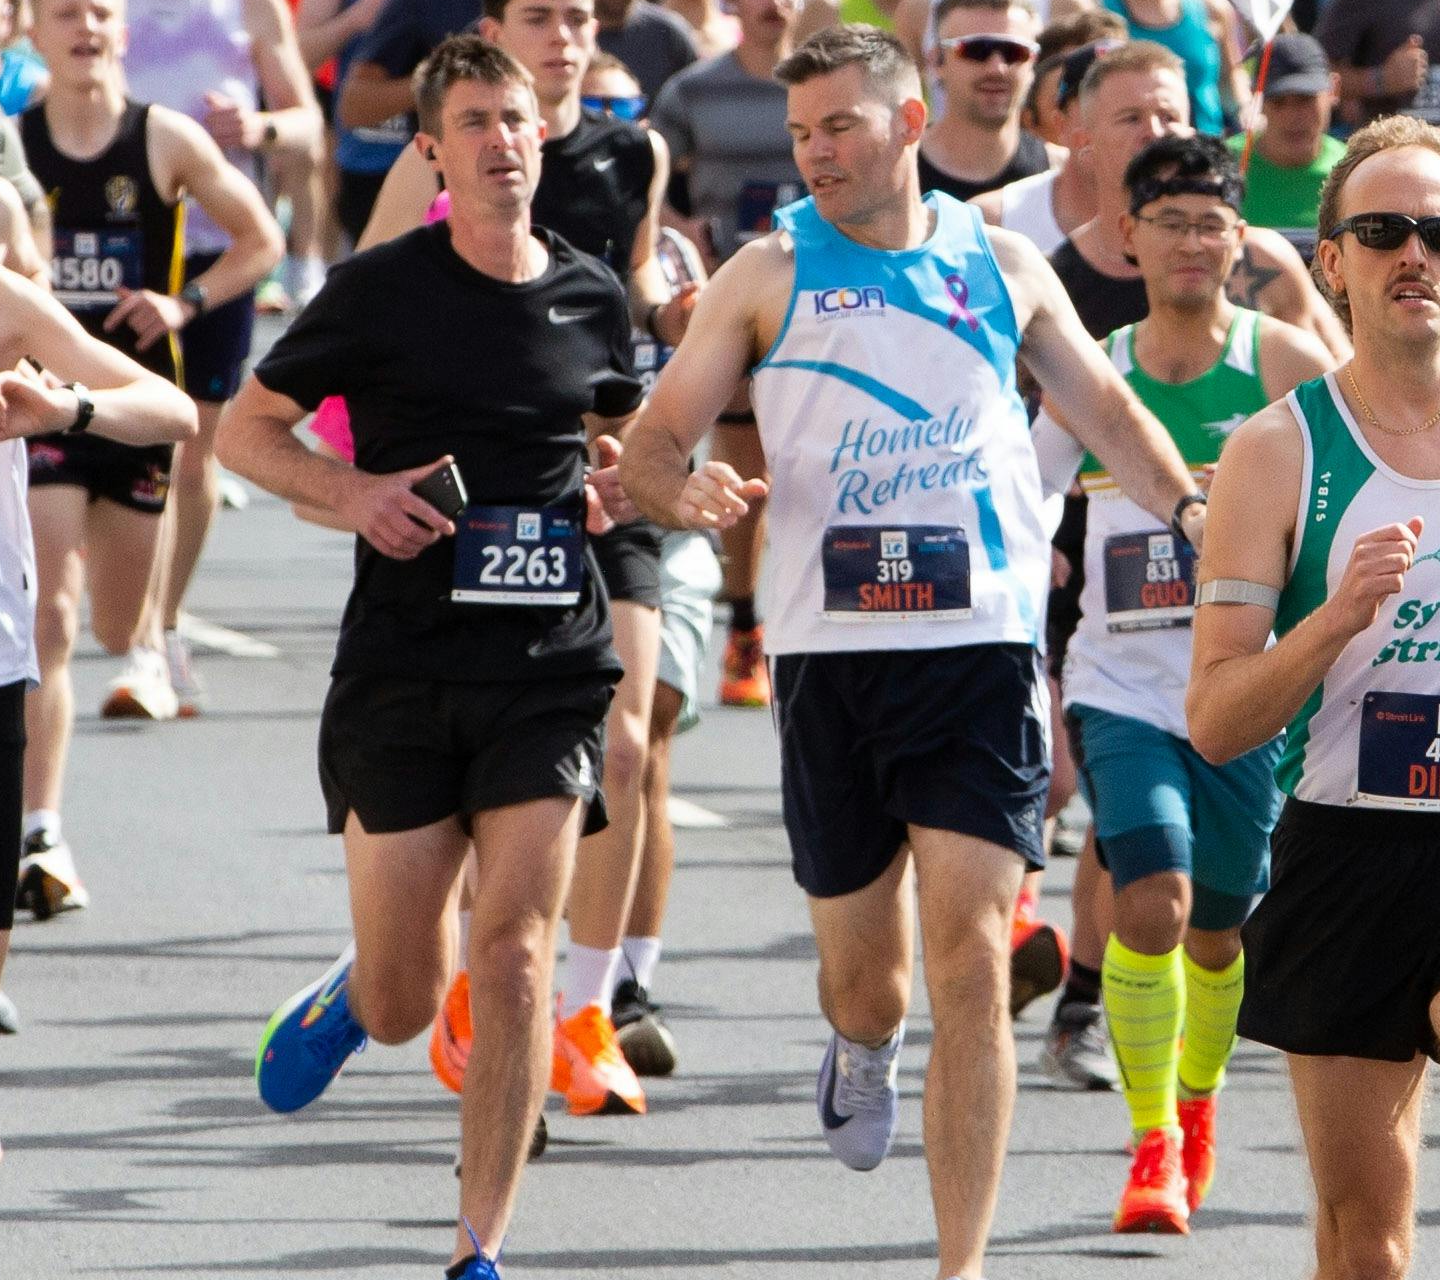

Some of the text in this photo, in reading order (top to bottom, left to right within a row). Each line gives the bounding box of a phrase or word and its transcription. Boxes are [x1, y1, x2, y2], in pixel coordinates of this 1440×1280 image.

[836, 454, 990, 516] Retreats
[1315, 471, 1332, 522] SUBA
[479, 545, 568, 587] 2263
[876, 560, 913, 584] 319
[1146, 559, 1180, 583] 831
[857, 581, 936, 611] SMITH
[1140, 579, 1189, 609] GUO
